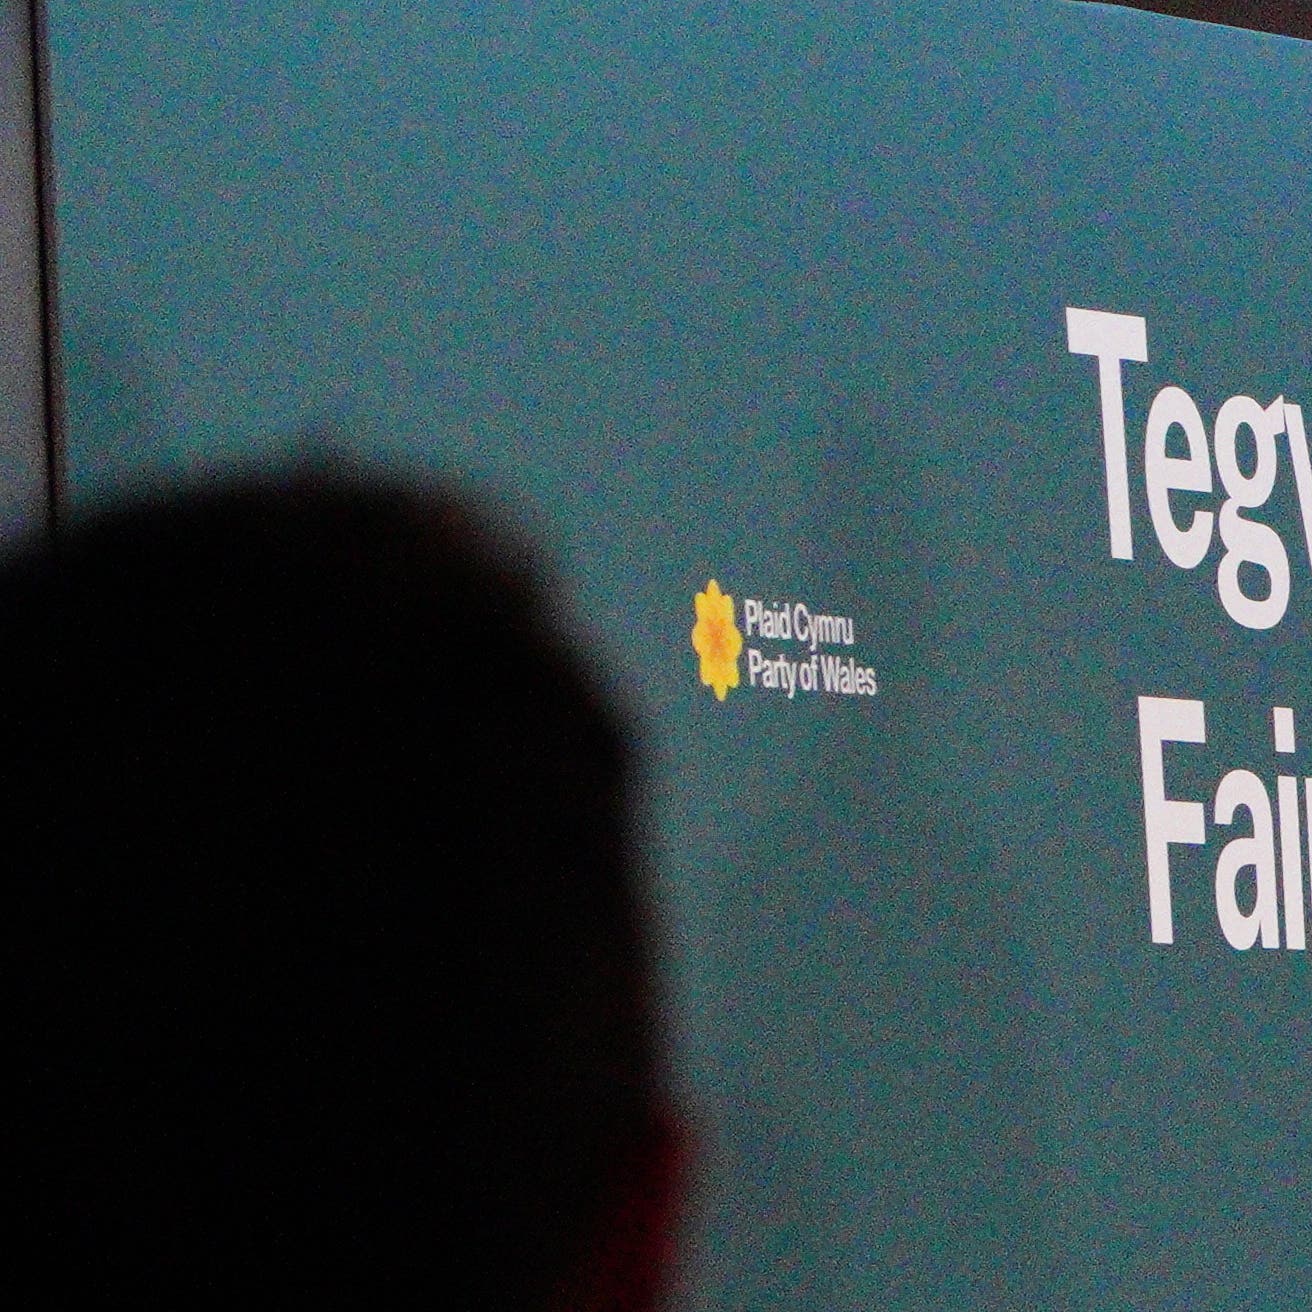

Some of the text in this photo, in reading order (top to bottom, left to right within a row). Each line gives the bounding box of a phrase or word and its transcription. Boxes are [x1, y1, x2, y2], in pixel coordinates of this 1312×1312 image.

[744, 598, 855, 651] Plaid Cymru
[748, 649, 877, 699] Party of Wales
